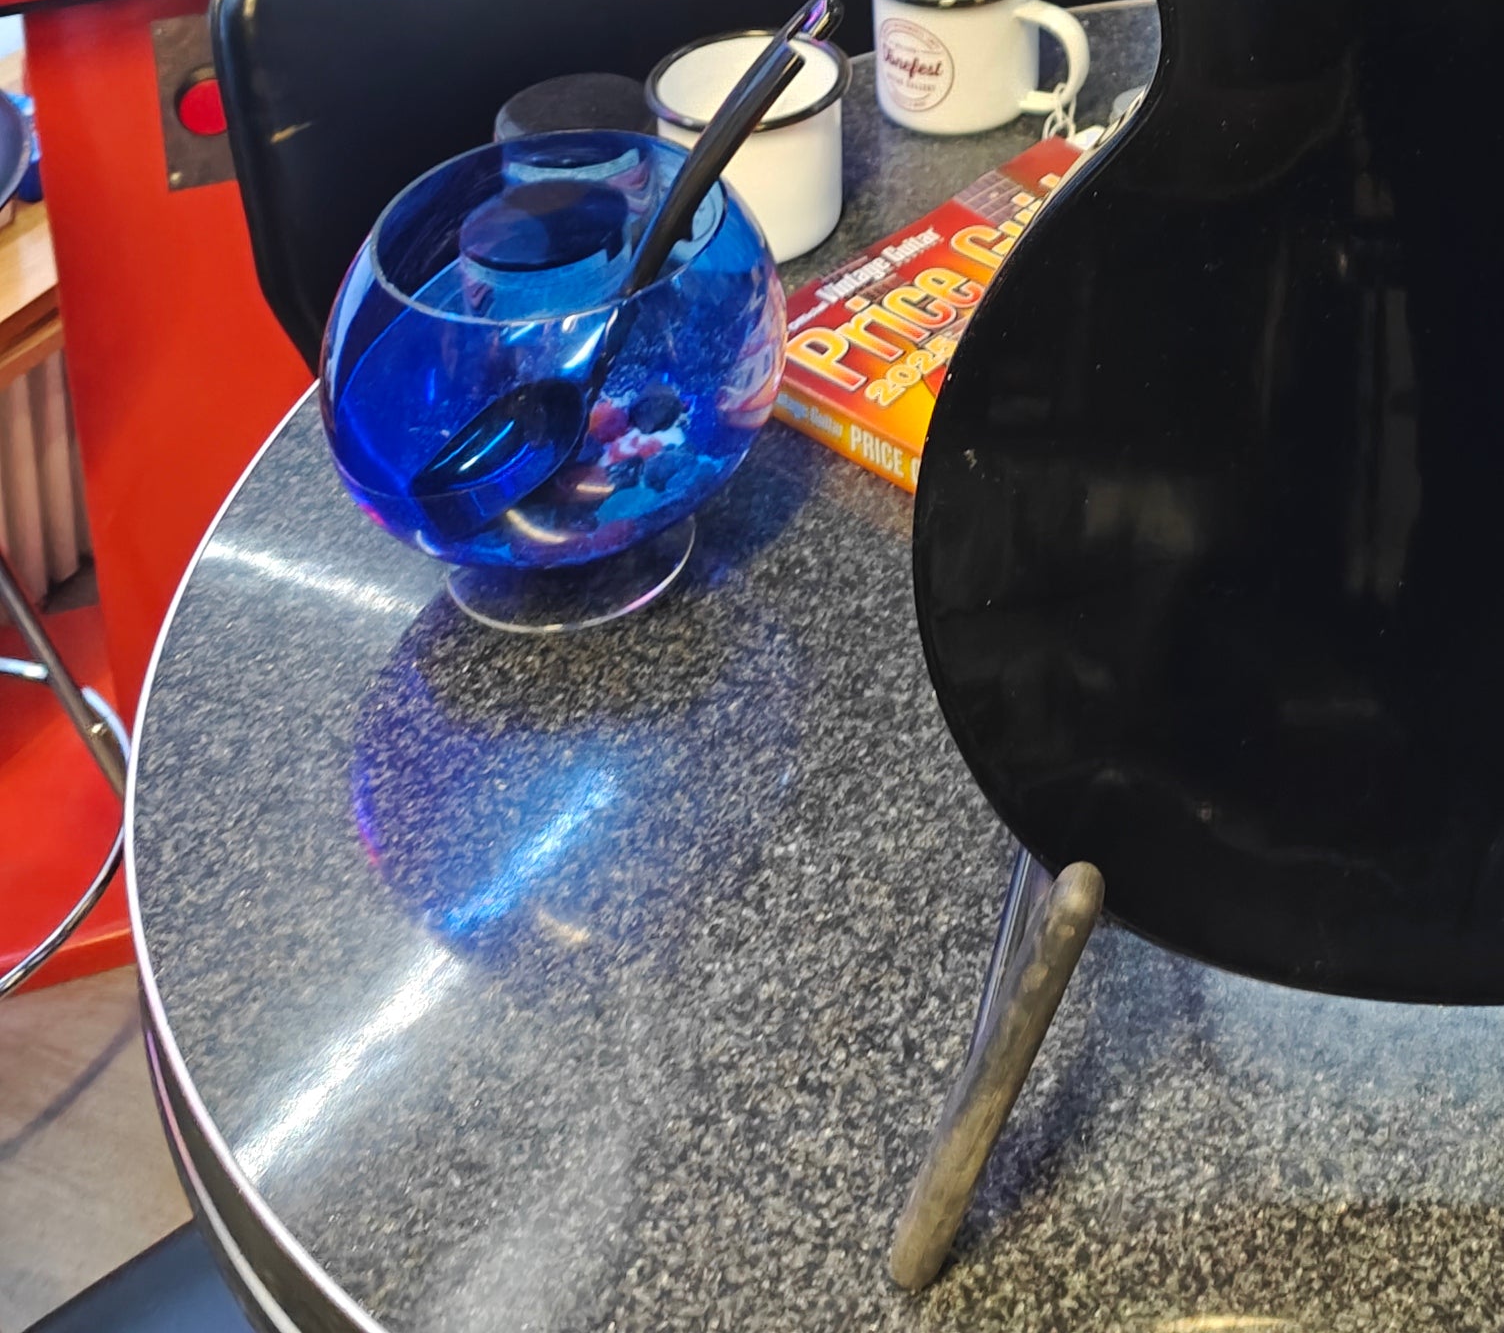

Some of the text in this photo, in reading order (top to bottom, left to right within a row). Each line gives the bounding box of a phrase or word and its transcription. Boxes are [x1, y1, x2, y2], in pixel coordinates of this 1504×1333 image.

[815, 256, 891, 304] Vintage
[880, 225, 943, 267] Guitar
[784, 266, 986, 393] Price
[863, 333, 959, 409] 2025
[849, 422, 905, 480] PRICE
